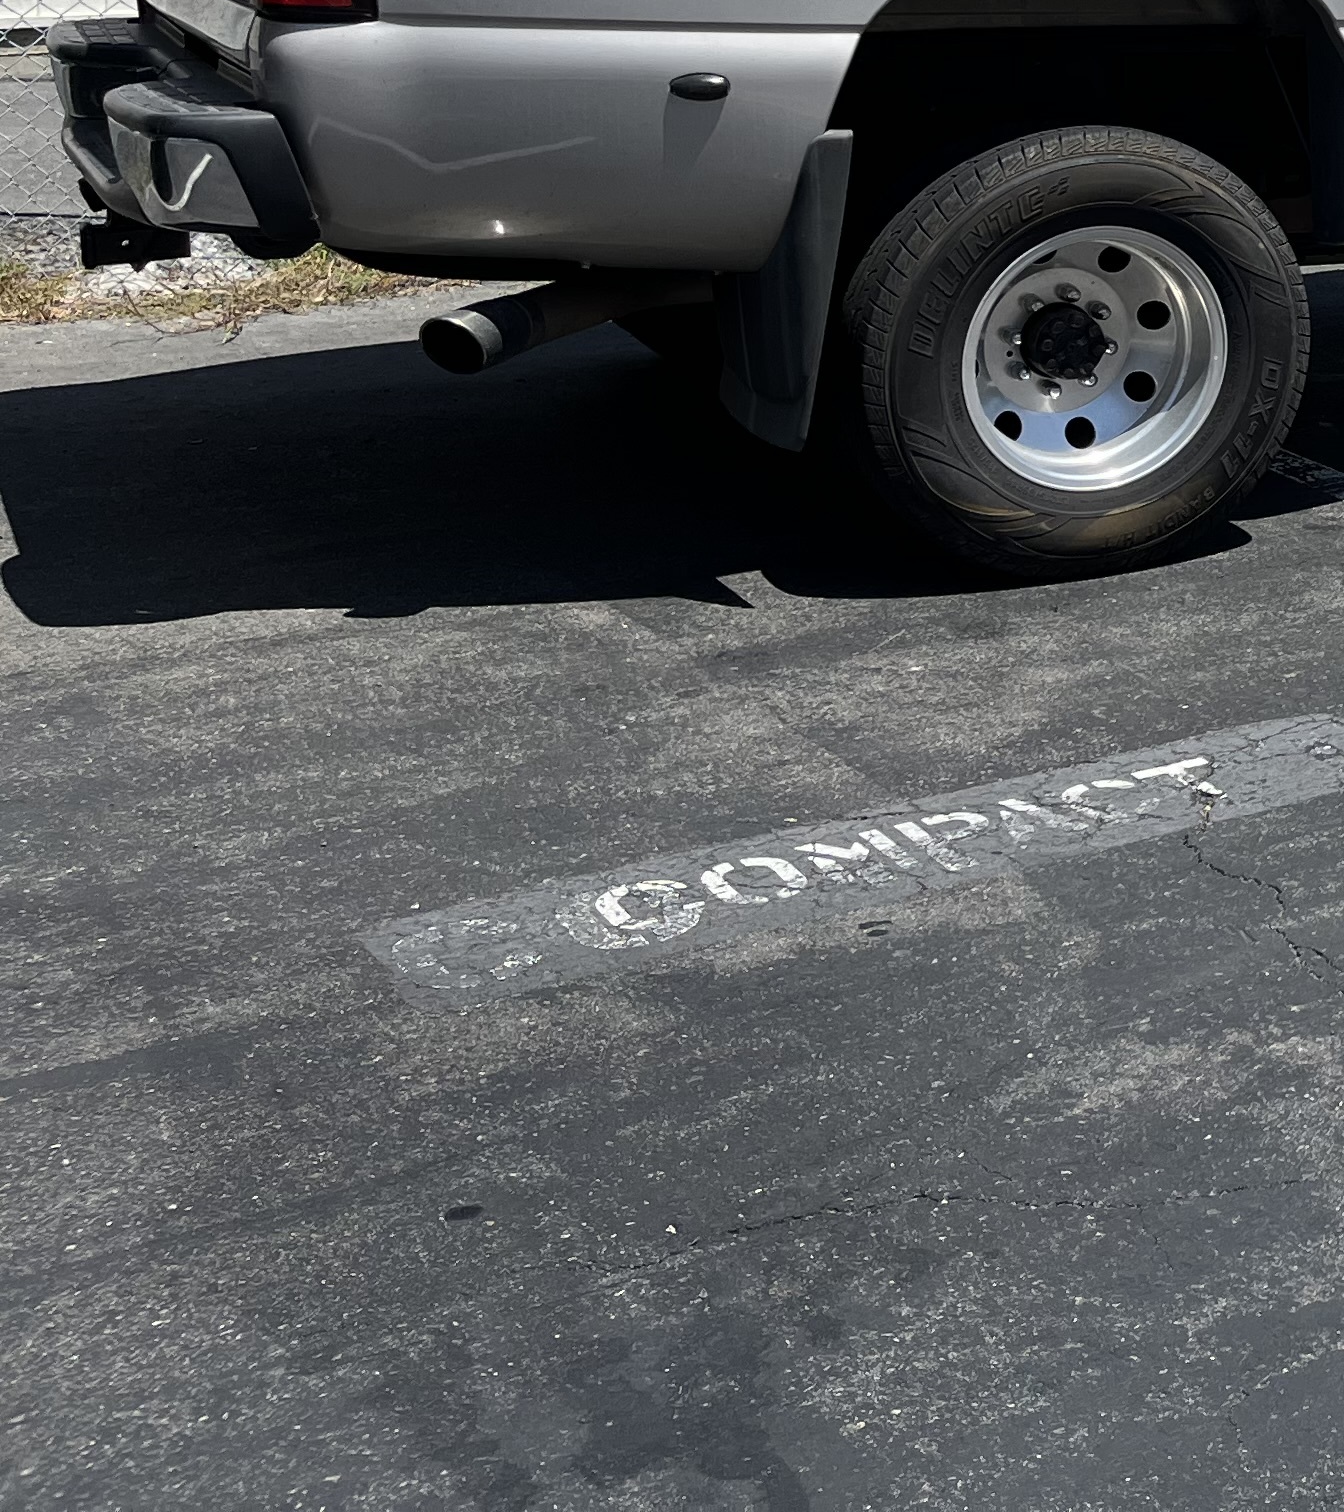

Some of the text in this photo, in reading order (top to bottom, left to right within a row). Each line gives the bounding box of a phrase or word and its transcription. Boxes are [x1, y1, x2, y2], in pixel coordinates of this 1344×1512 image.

[907, 184, 1047, 360] DELINTE
[1219, 355, 1284, 480] DX-11
[590, 755, 1229, 934] COMPACT
